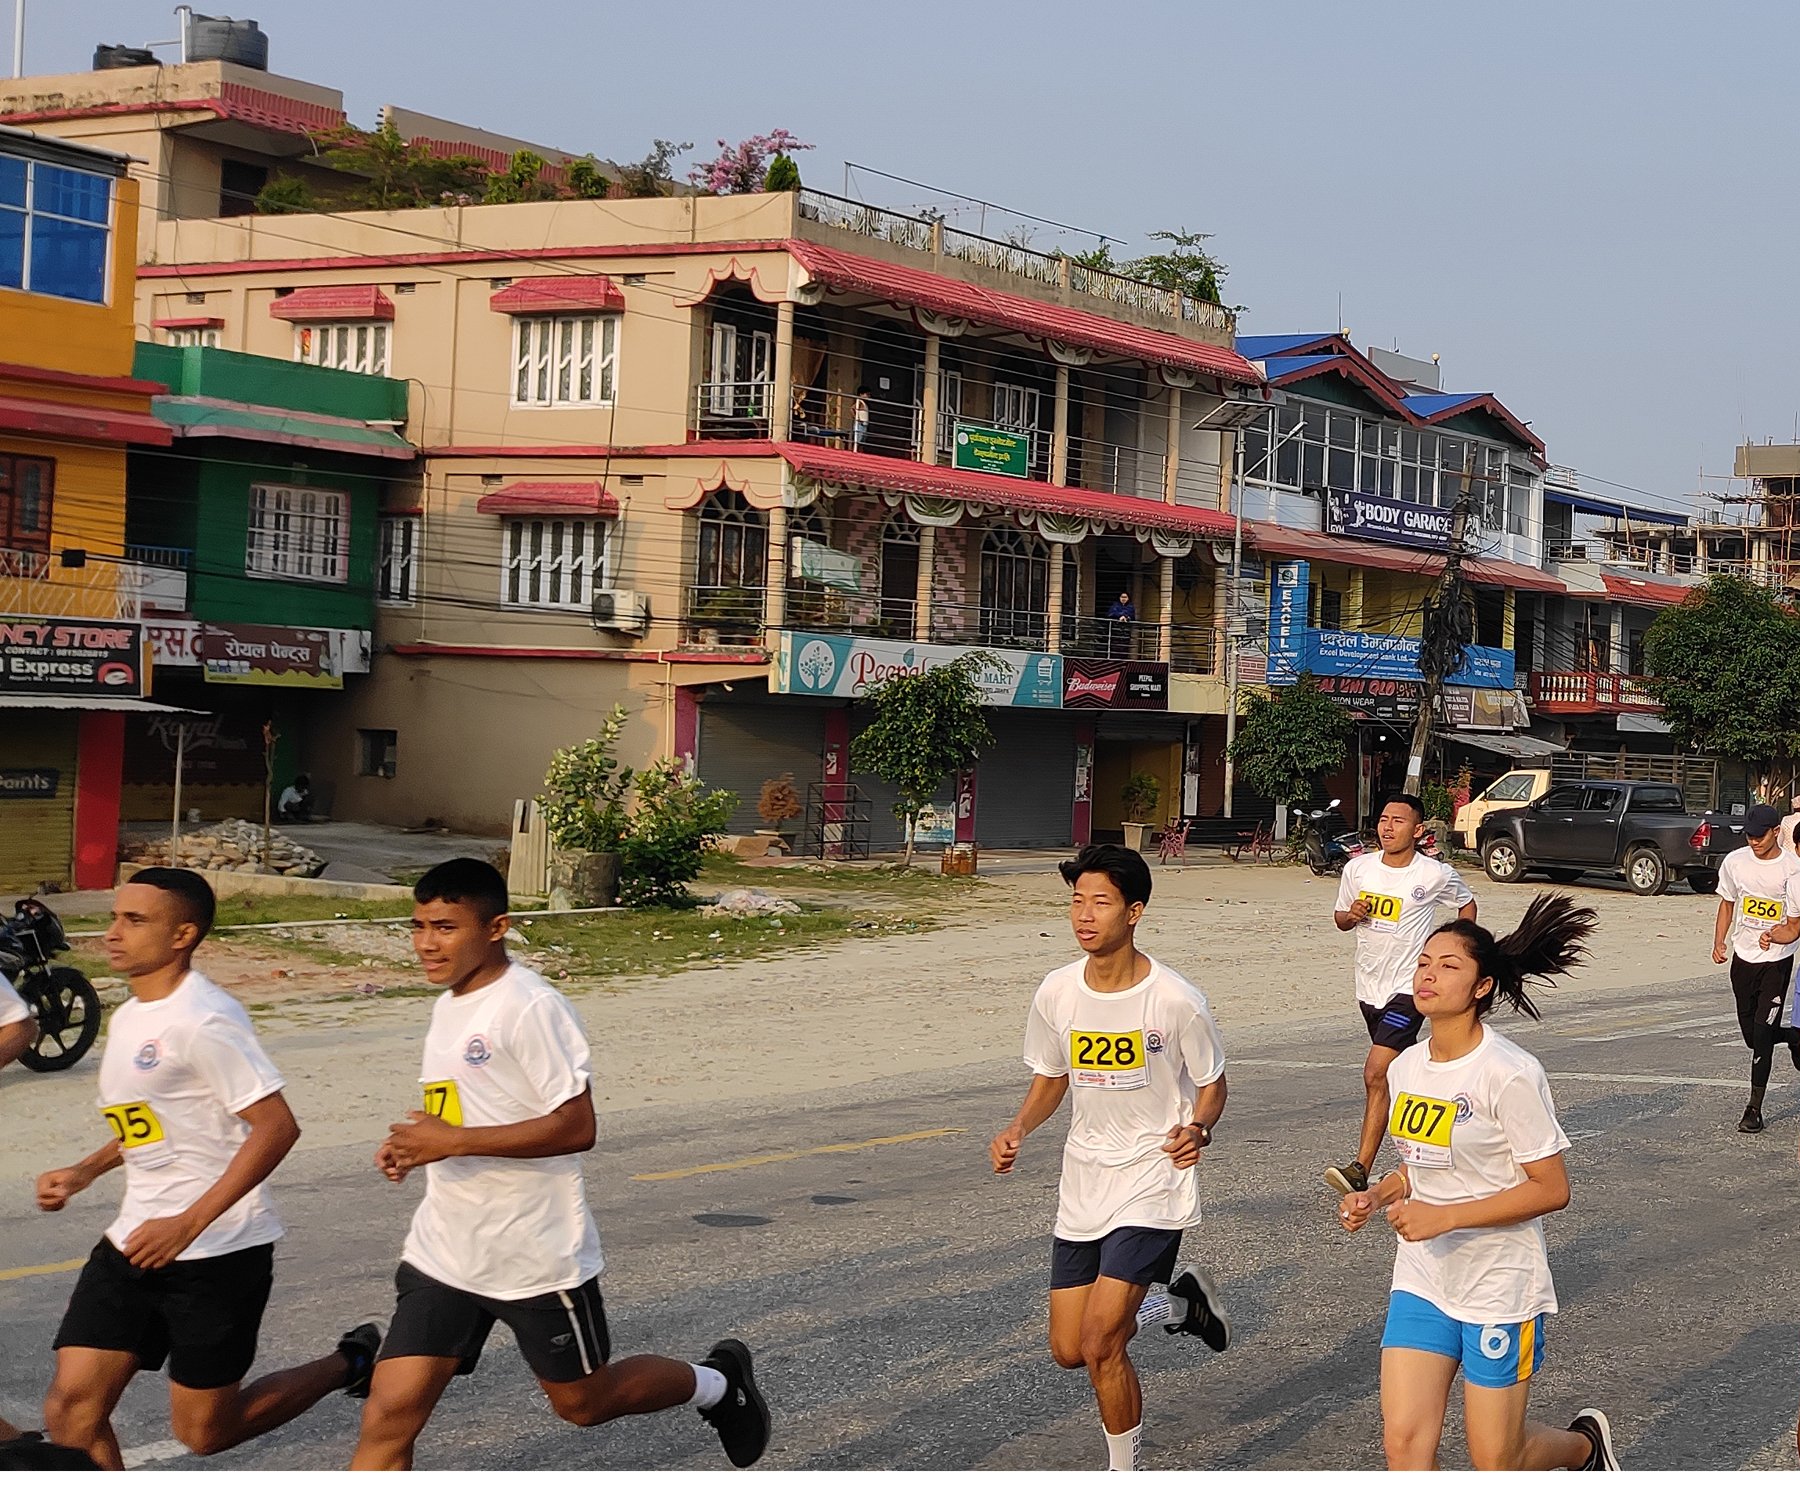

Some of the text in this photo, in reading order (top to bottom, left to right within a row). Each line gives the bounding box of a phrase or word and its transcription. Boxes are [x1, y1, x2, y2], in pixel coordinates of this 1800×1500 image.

[1365, 502, 1400, 526] BODY
[1403, 510, 1453, 535] GARAGE
[1331, 525, 1345, 534] GYM
[1280, 590, 1293, 649] EXCEL
[52, 626, 132, 649] STORE
[225, 638, 266, 658] रोयल
[11, 658, 93, 677] Express
[984, 673, 1013, 685] MART
[1067, 678, 1117, 691] Budweiser
[1353, 697, 1374, 706] WEAR
[1748, 899, 1776, 918] 256
[1078, 1035, 1136, 1066] 228
[1400, 1099, 1446, 1138] 107
[1481, 1325, 1510, 1360] 6
